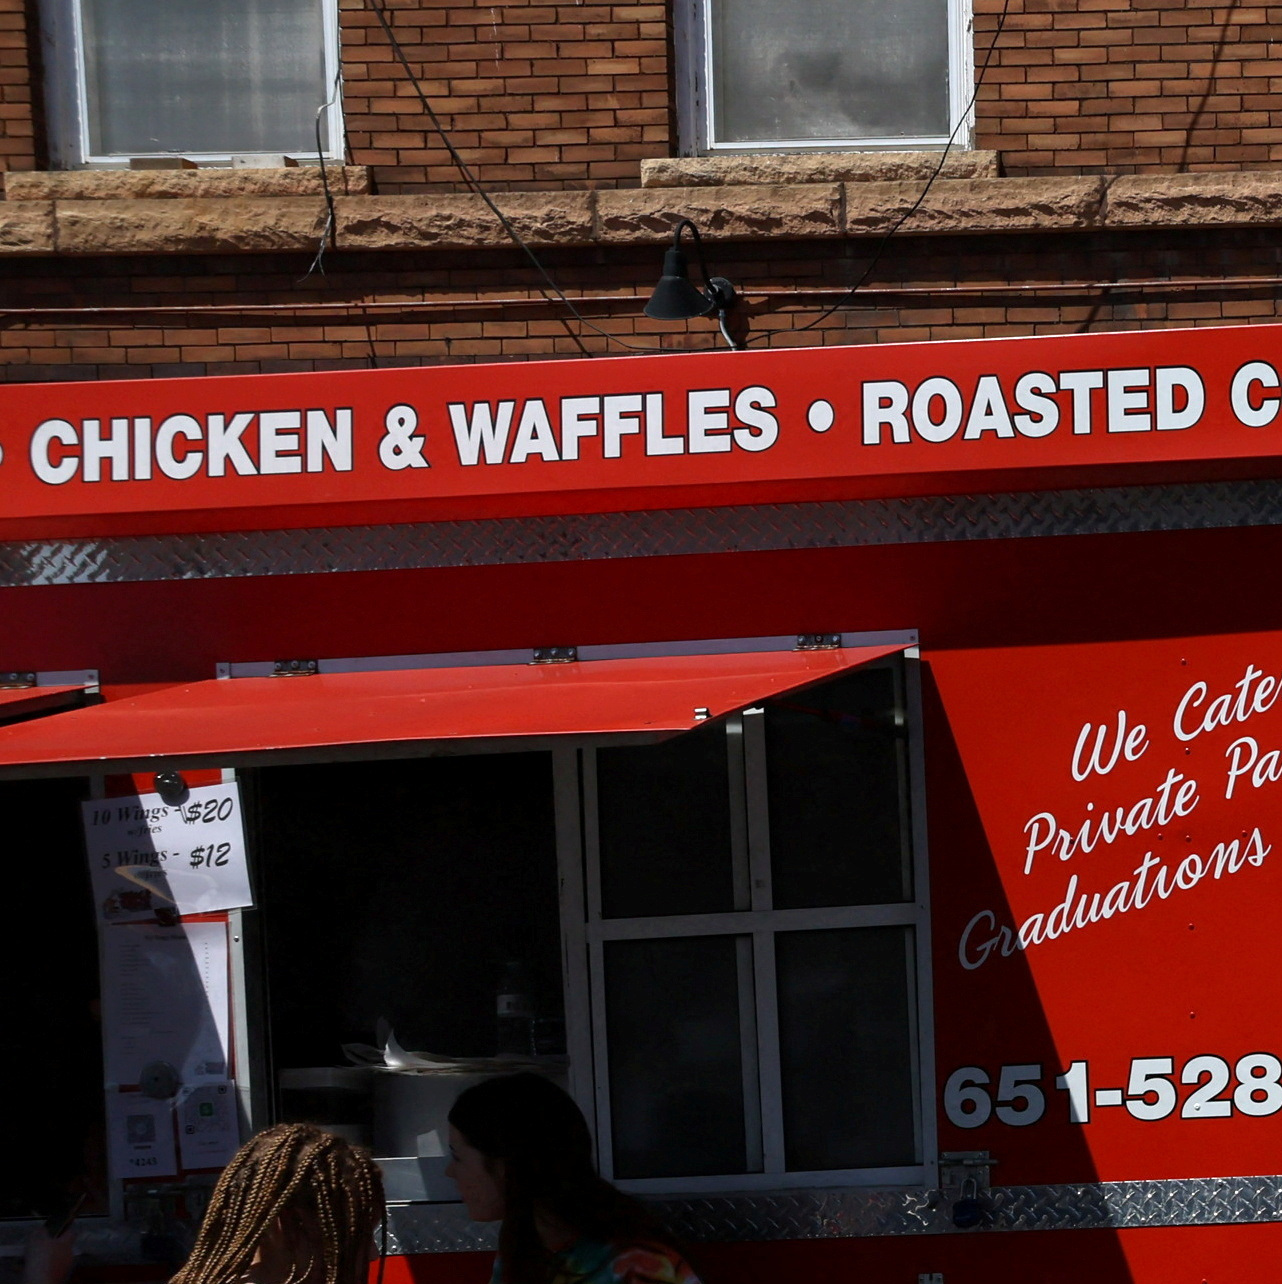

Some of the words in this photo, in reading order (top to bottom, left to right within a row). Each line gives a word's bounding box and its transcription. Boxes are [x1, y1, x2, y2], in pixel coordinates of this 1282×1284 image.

[29, 406, 353, 486] CHICKEN
[377, 402, 429, 470] &
[447, 384, 780, 467] WAFFLES
[861, 364, 1206, 445] ROASTED
[1070, 709, 1149, 782] We
[93, 810, 111, 826] 10
[118, 805, 169, 823] Wings
[185, 797, 233, 825] $20
[102, 853, 111, 869] 5
[117, 849, 168, 868] Wings
[189, 842, 231, 869] $12
[1023, 768, 1199, 875] Private
[958, 827, 1272, 971] Graduations
